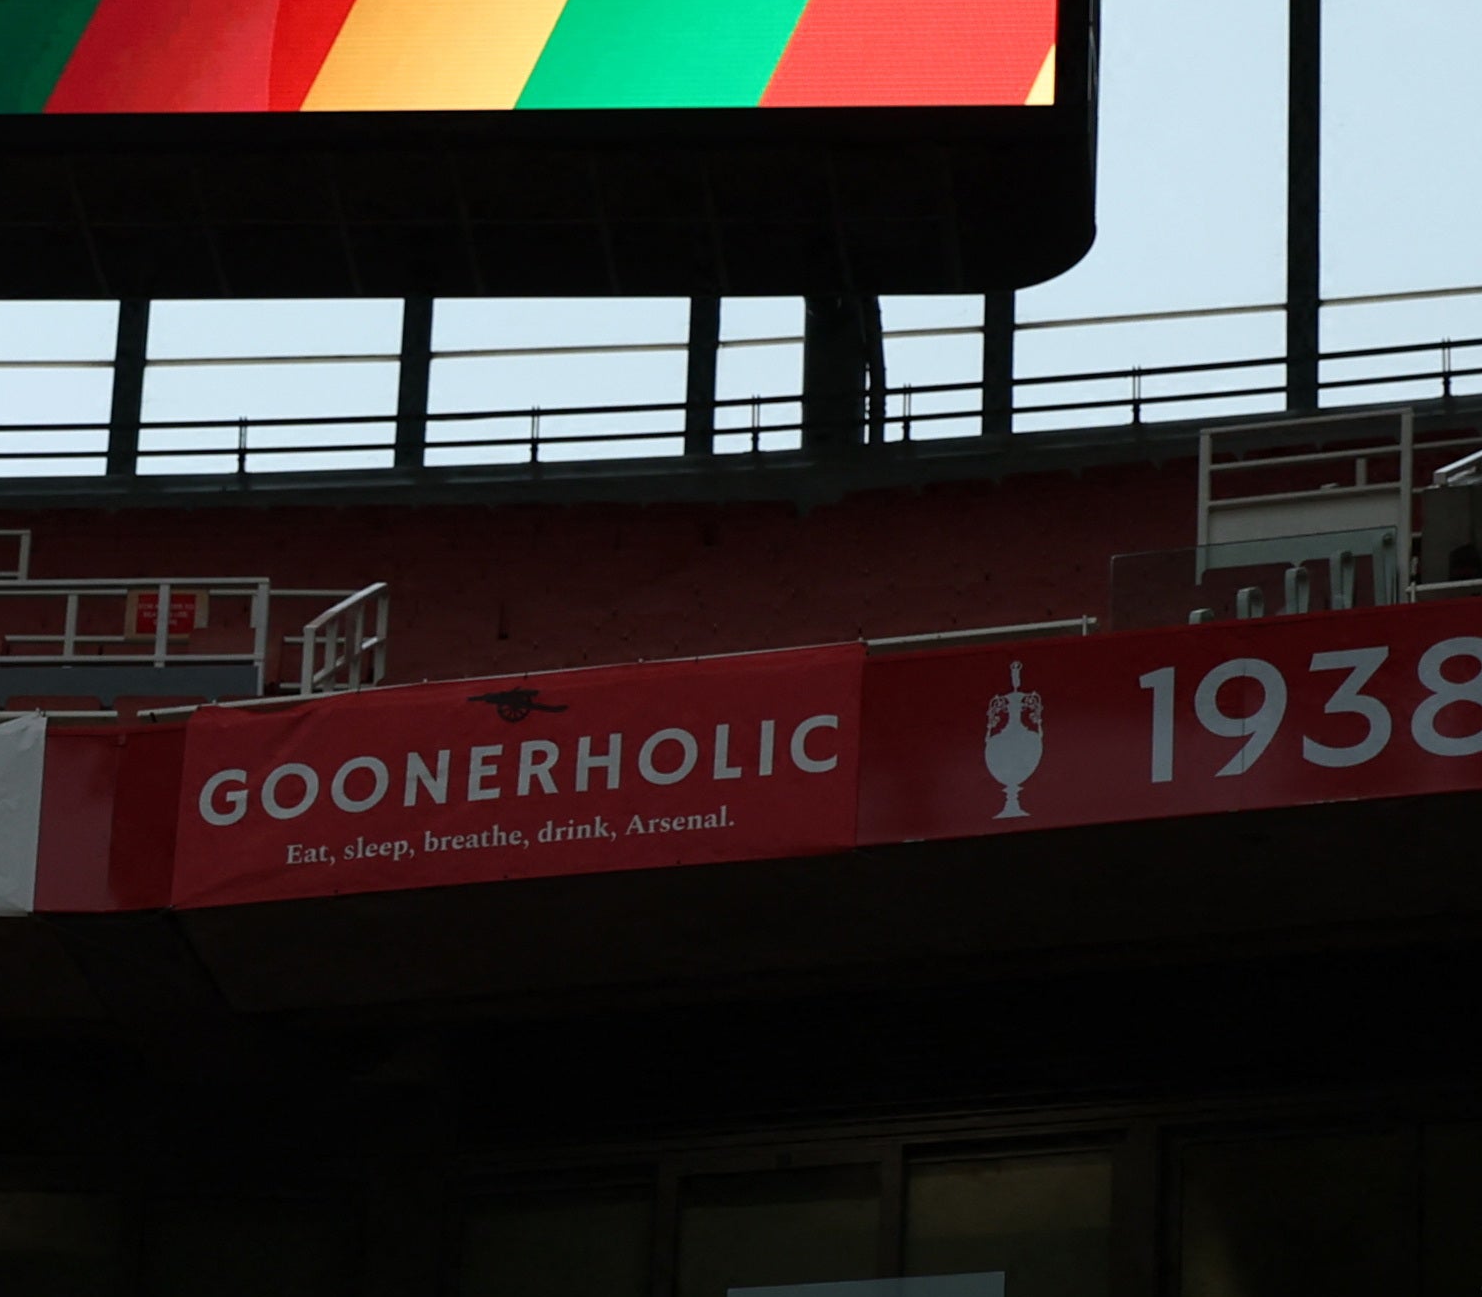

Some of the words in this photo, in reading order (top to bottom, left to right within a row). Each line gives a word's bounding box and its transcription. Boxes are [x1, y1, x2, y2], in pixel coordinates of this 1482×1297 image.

[198, 714, 839, 827] GOONERHOLIC
[285, 844, 336, 865] Eat,
[343, 835, 415, 861] sleep,
[424, 828, 529, 854] breathe,
[537, 815, 617, 843] drink,
[626, 805, 734, 835] Arsenal.
